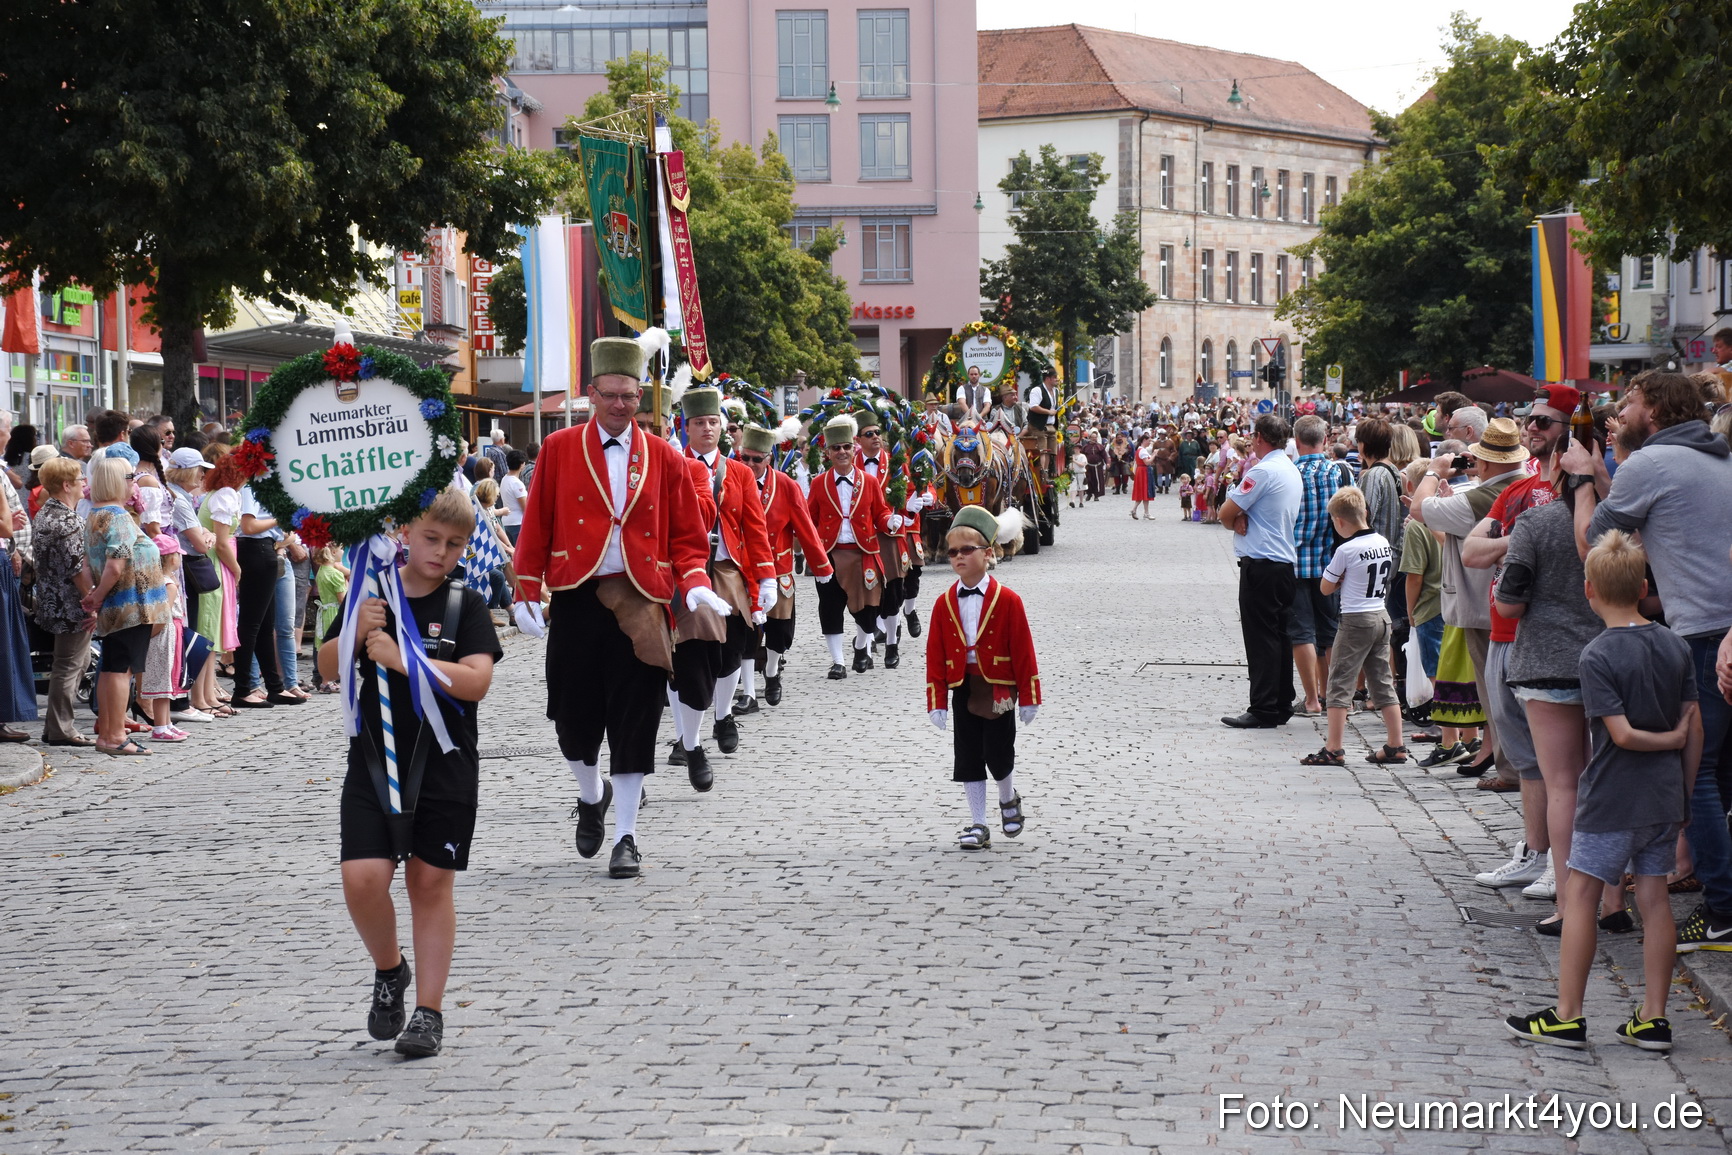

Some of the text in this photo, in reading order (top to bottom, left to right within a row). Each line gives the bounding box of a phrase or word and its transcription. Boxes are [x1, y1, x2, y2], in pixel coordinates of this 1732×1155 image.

[400, 292, 421, 305] café
[848, 301, 915, 319] rkasse
[310, 403, 392, 425] Neumarkter
[296, 416, 409, 447] Lammsbräu
[288, 446, 423, 483] Schäffler-
[328, 485, 392, 510] Tanz
[1366, 560, 1392, 598] 13
